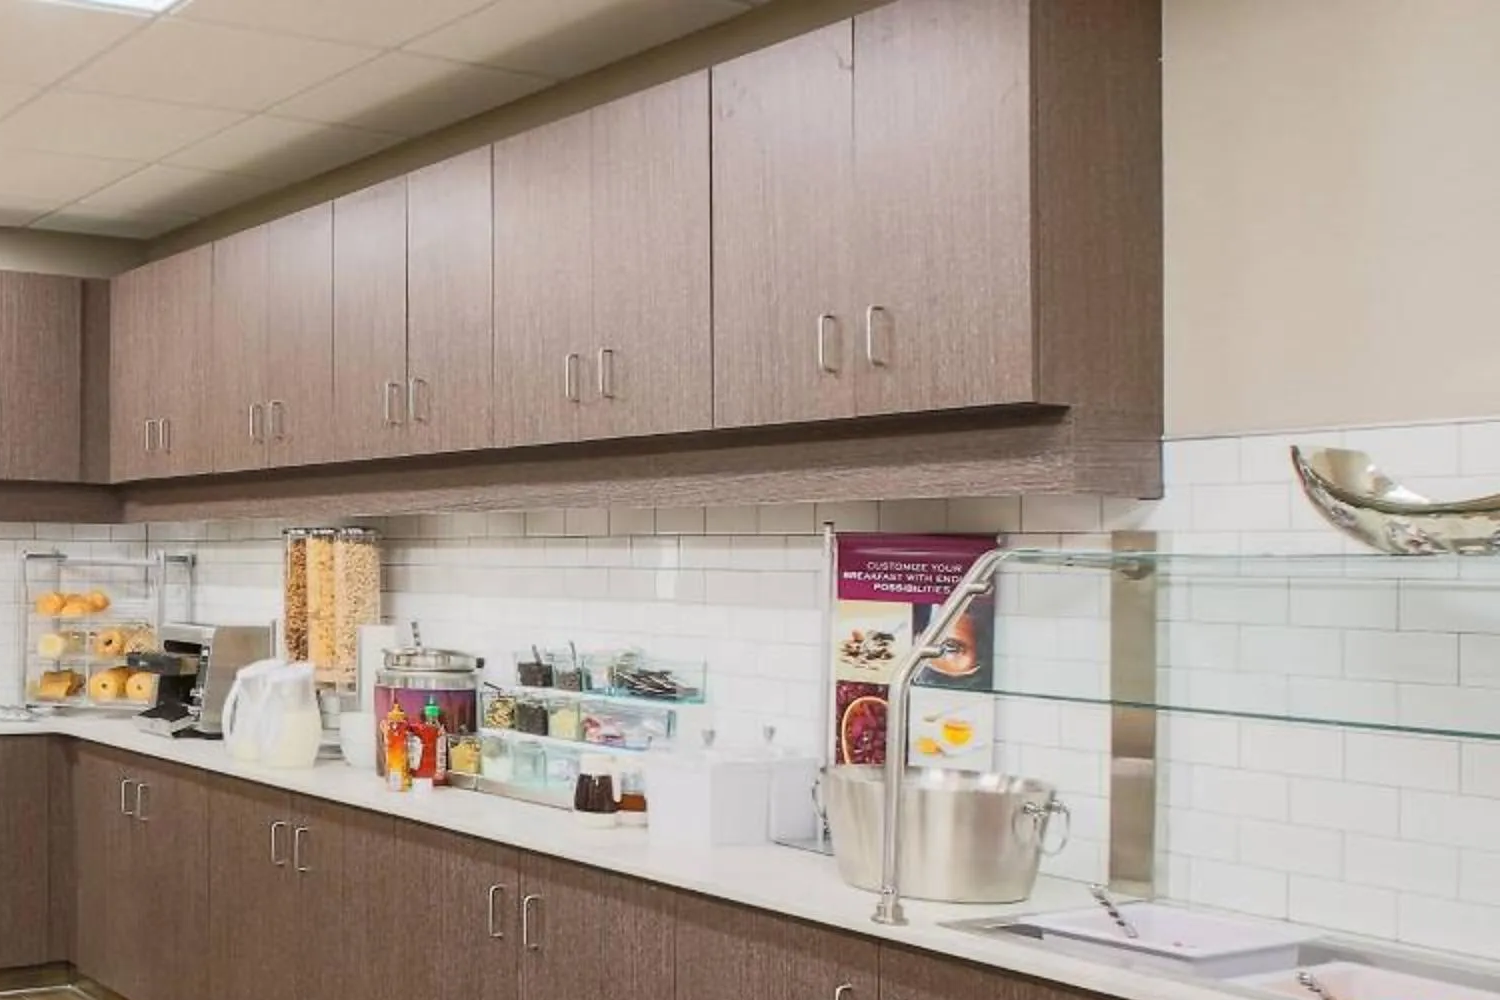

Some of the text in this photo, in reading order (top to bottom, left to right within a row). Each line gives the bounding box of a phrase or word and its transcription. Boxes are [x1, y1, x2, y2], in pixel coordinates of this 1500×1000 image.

[866, 561, 963, 573] CUSTOMIZE YOUR
[843, 571, 963, 584] BREAKFAST WITH END
[873, 583, 951, 595] POSSIBILITIES
